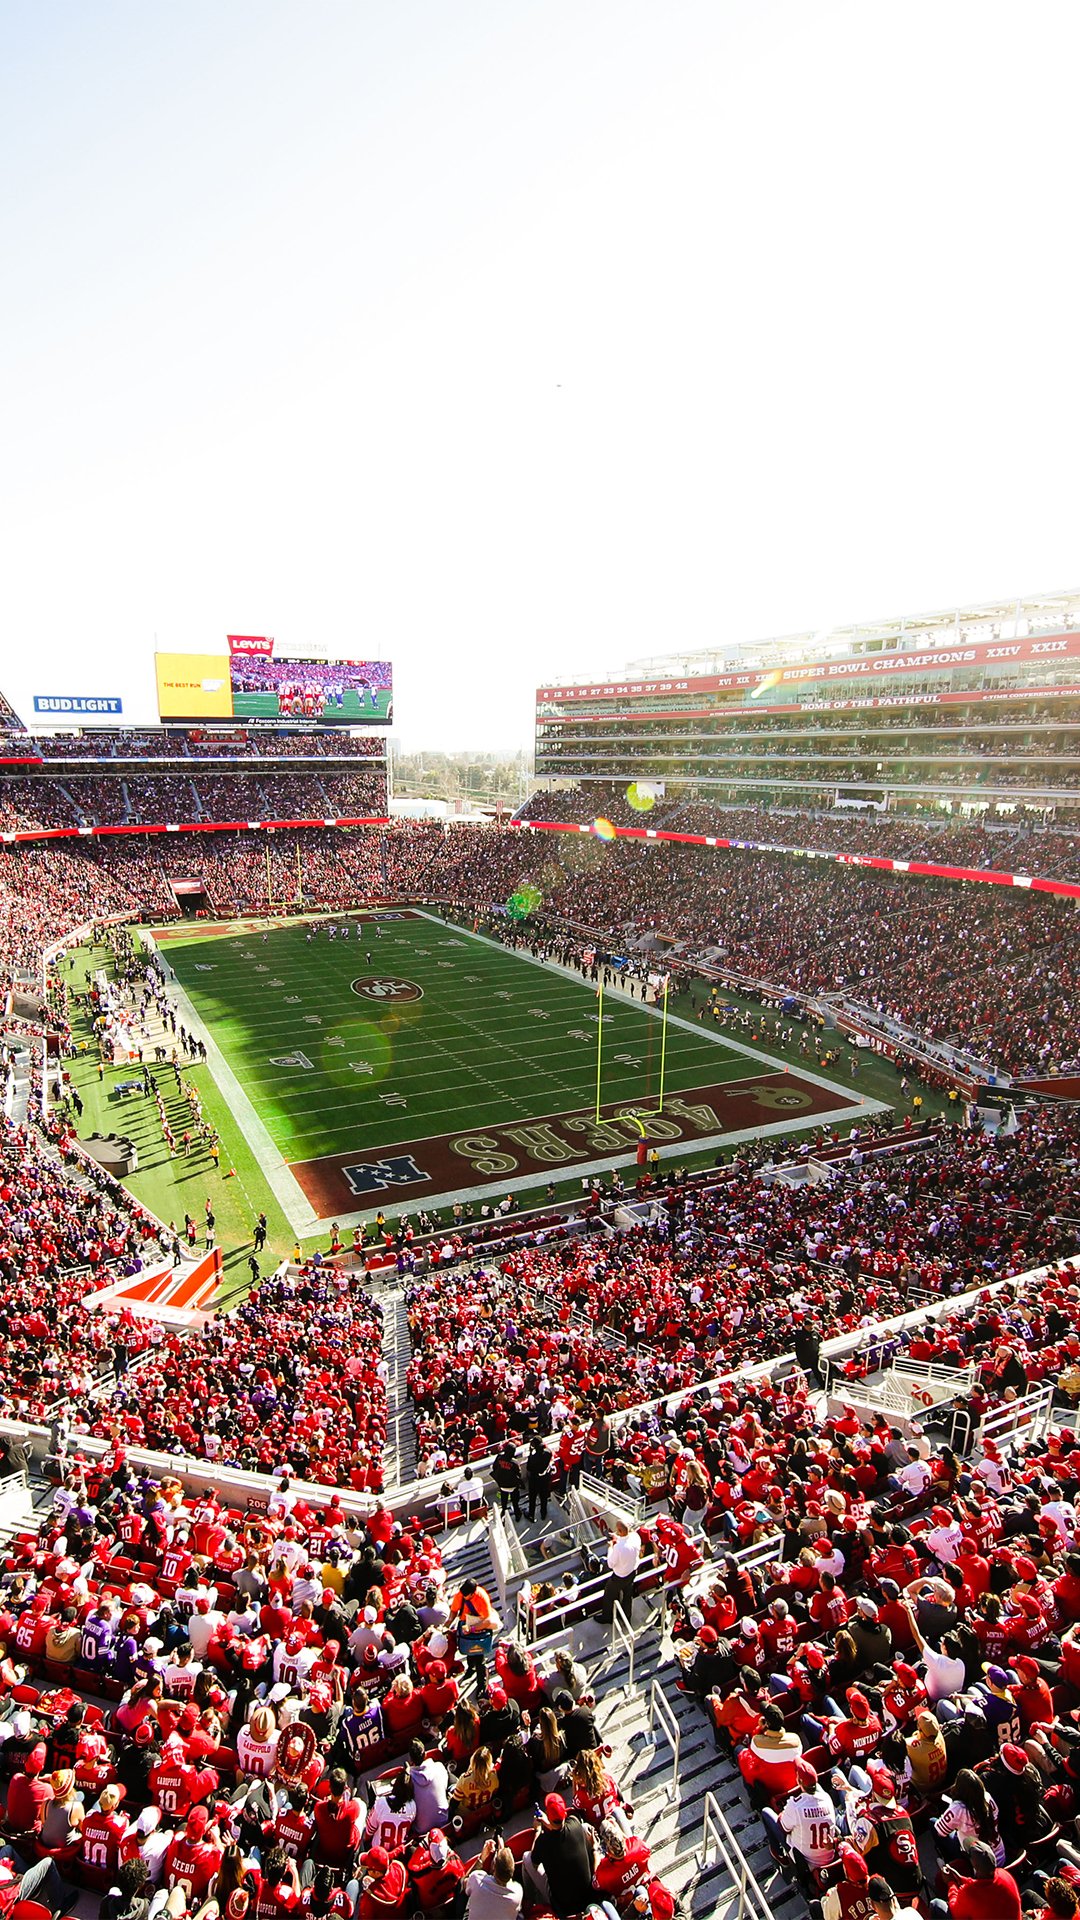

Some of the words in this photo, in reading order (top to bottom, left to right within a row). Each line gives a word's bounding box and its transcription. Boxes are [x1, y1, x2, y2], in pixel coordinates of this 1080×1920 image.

[718, 678, 732, 686] XVI
[736, 676, 750, 684] XIX
[783, 667, 825, 680] SUPER
[828, 662, 869, 674] BOWL
[873, 650, 976, 669] CHAMPIONS
[986, 646, 1022, 658] XXIV
[1030, 640, 1068, 654] XXIX
[617, 686, 628, 694] 34
[646, 684, 657, 692] 37
[674, 682, 688, 690] 42
[38, 698, 72, 710] BUD
[73, 699, 118, 712] LIGHT
[801, 701, 832, 711] HOME
[834, 700, 848, 709] OF
[850, 698, 874, 708] THE
[878, 695, 941, 706] FAITHFUL
[348, 1061, 374, 1074] 20
[378, 1092, 407, 1107] 10
[1020, 1324, 1033, 1339] 21
[998, 1469, 1012, 1488] 10
[248, 1499, 268, 1510] 206
[120, 1526, 132, 1540] 10
[310, 1539, 321, 1554] 21
[162, 1558, 178, 1578] 10
[16, 1626, 35, 1648] 85
[82, 1634, 96, 1660] 10
[279, 1662, 298, 1686] 10
[997, 1716, 1022, 1746] 82
[242, 1740, 272, 1754] GAROPPOLO
[243, 1754, 264, 1773] 10
[156, 1776, 182, 1787] GAROPPOLO
[158, 1790, 178, 1812] 10
[86, 1826, 110, 1841] GAROPPOLO
[279, 1824, 304, 1842] GAROPPOLO
[380, 1821, 412, 1850] 80
[810, 1822, 834, 1850] 10
[84, 1840, 108, 1867] 10
[896, 1834, 917, 1863] SF
[172, 1857, 196, 1874] DEEBO
[621, 1862, 640, 1884] CRAIG
